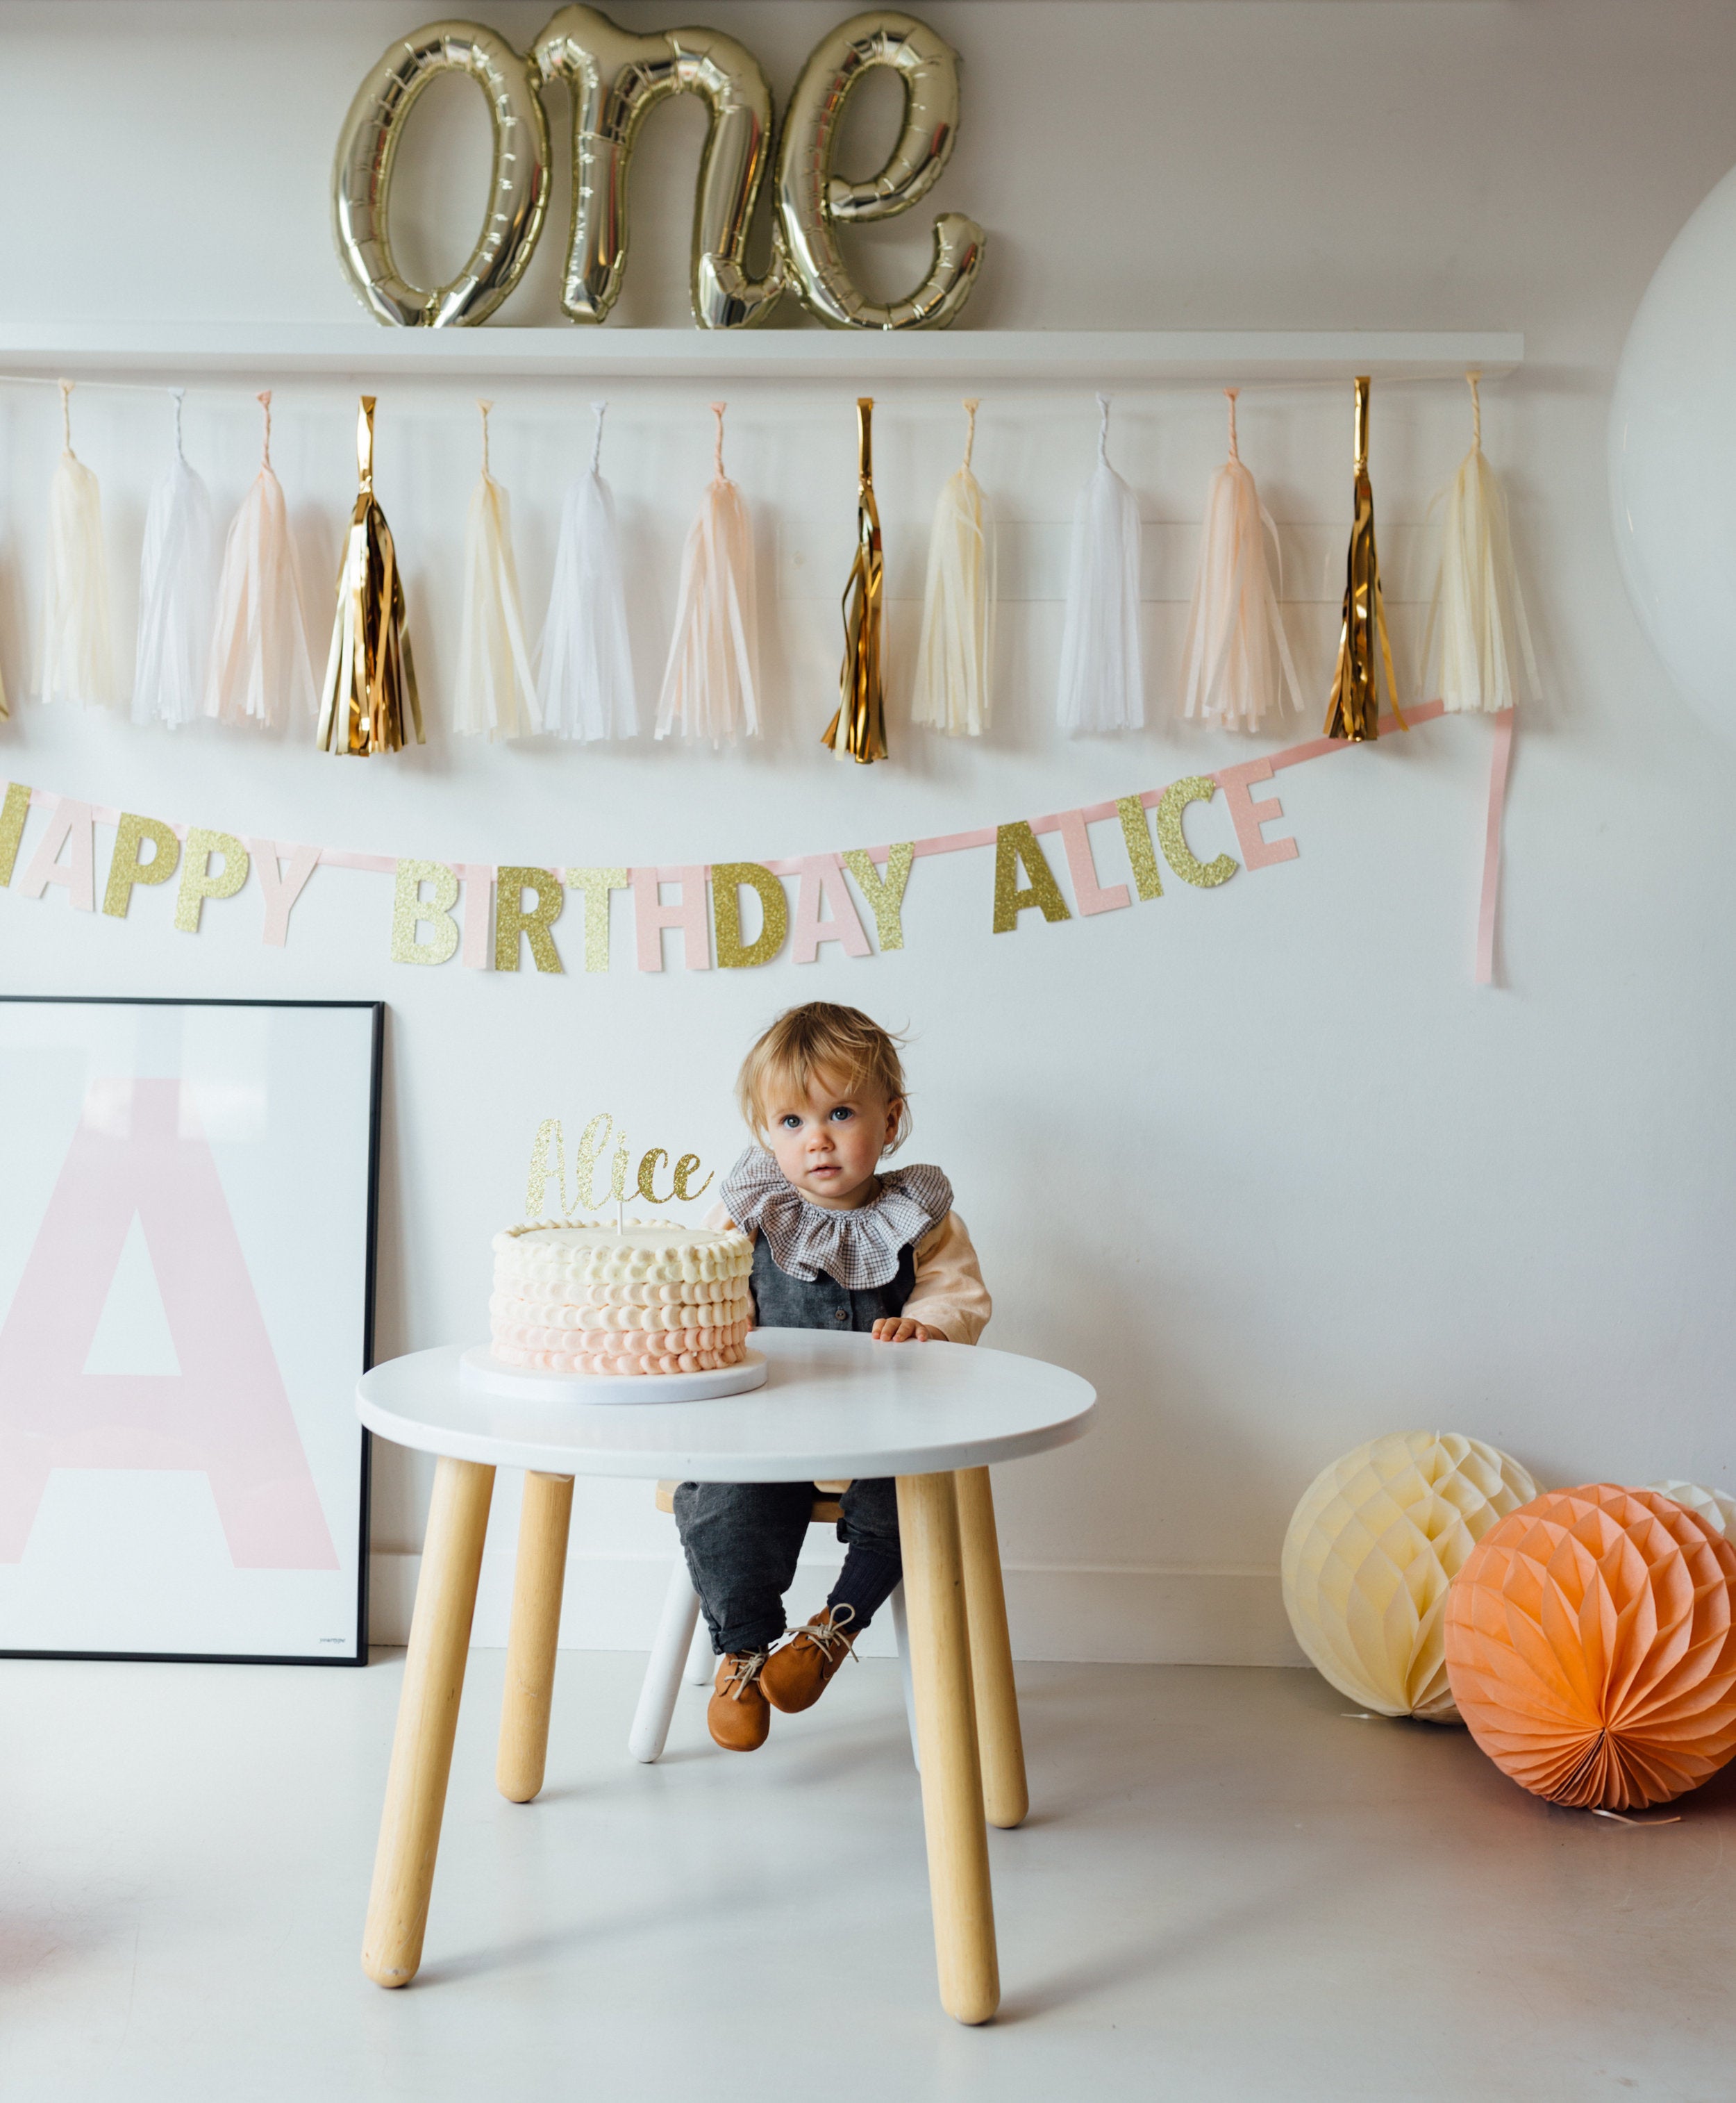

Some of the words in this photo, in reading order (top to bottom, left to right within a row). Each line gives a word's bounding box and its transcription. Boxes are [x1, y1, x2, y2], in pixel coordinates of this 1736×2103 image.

[330, 3, 985, 329] one
[391, 841, 915, 973] BIRTHDAY
[993, 758, 1299, 934] ALICE
[526, 1113, 715, 1217] Alice
[0, 1078, 341, 1570] A
